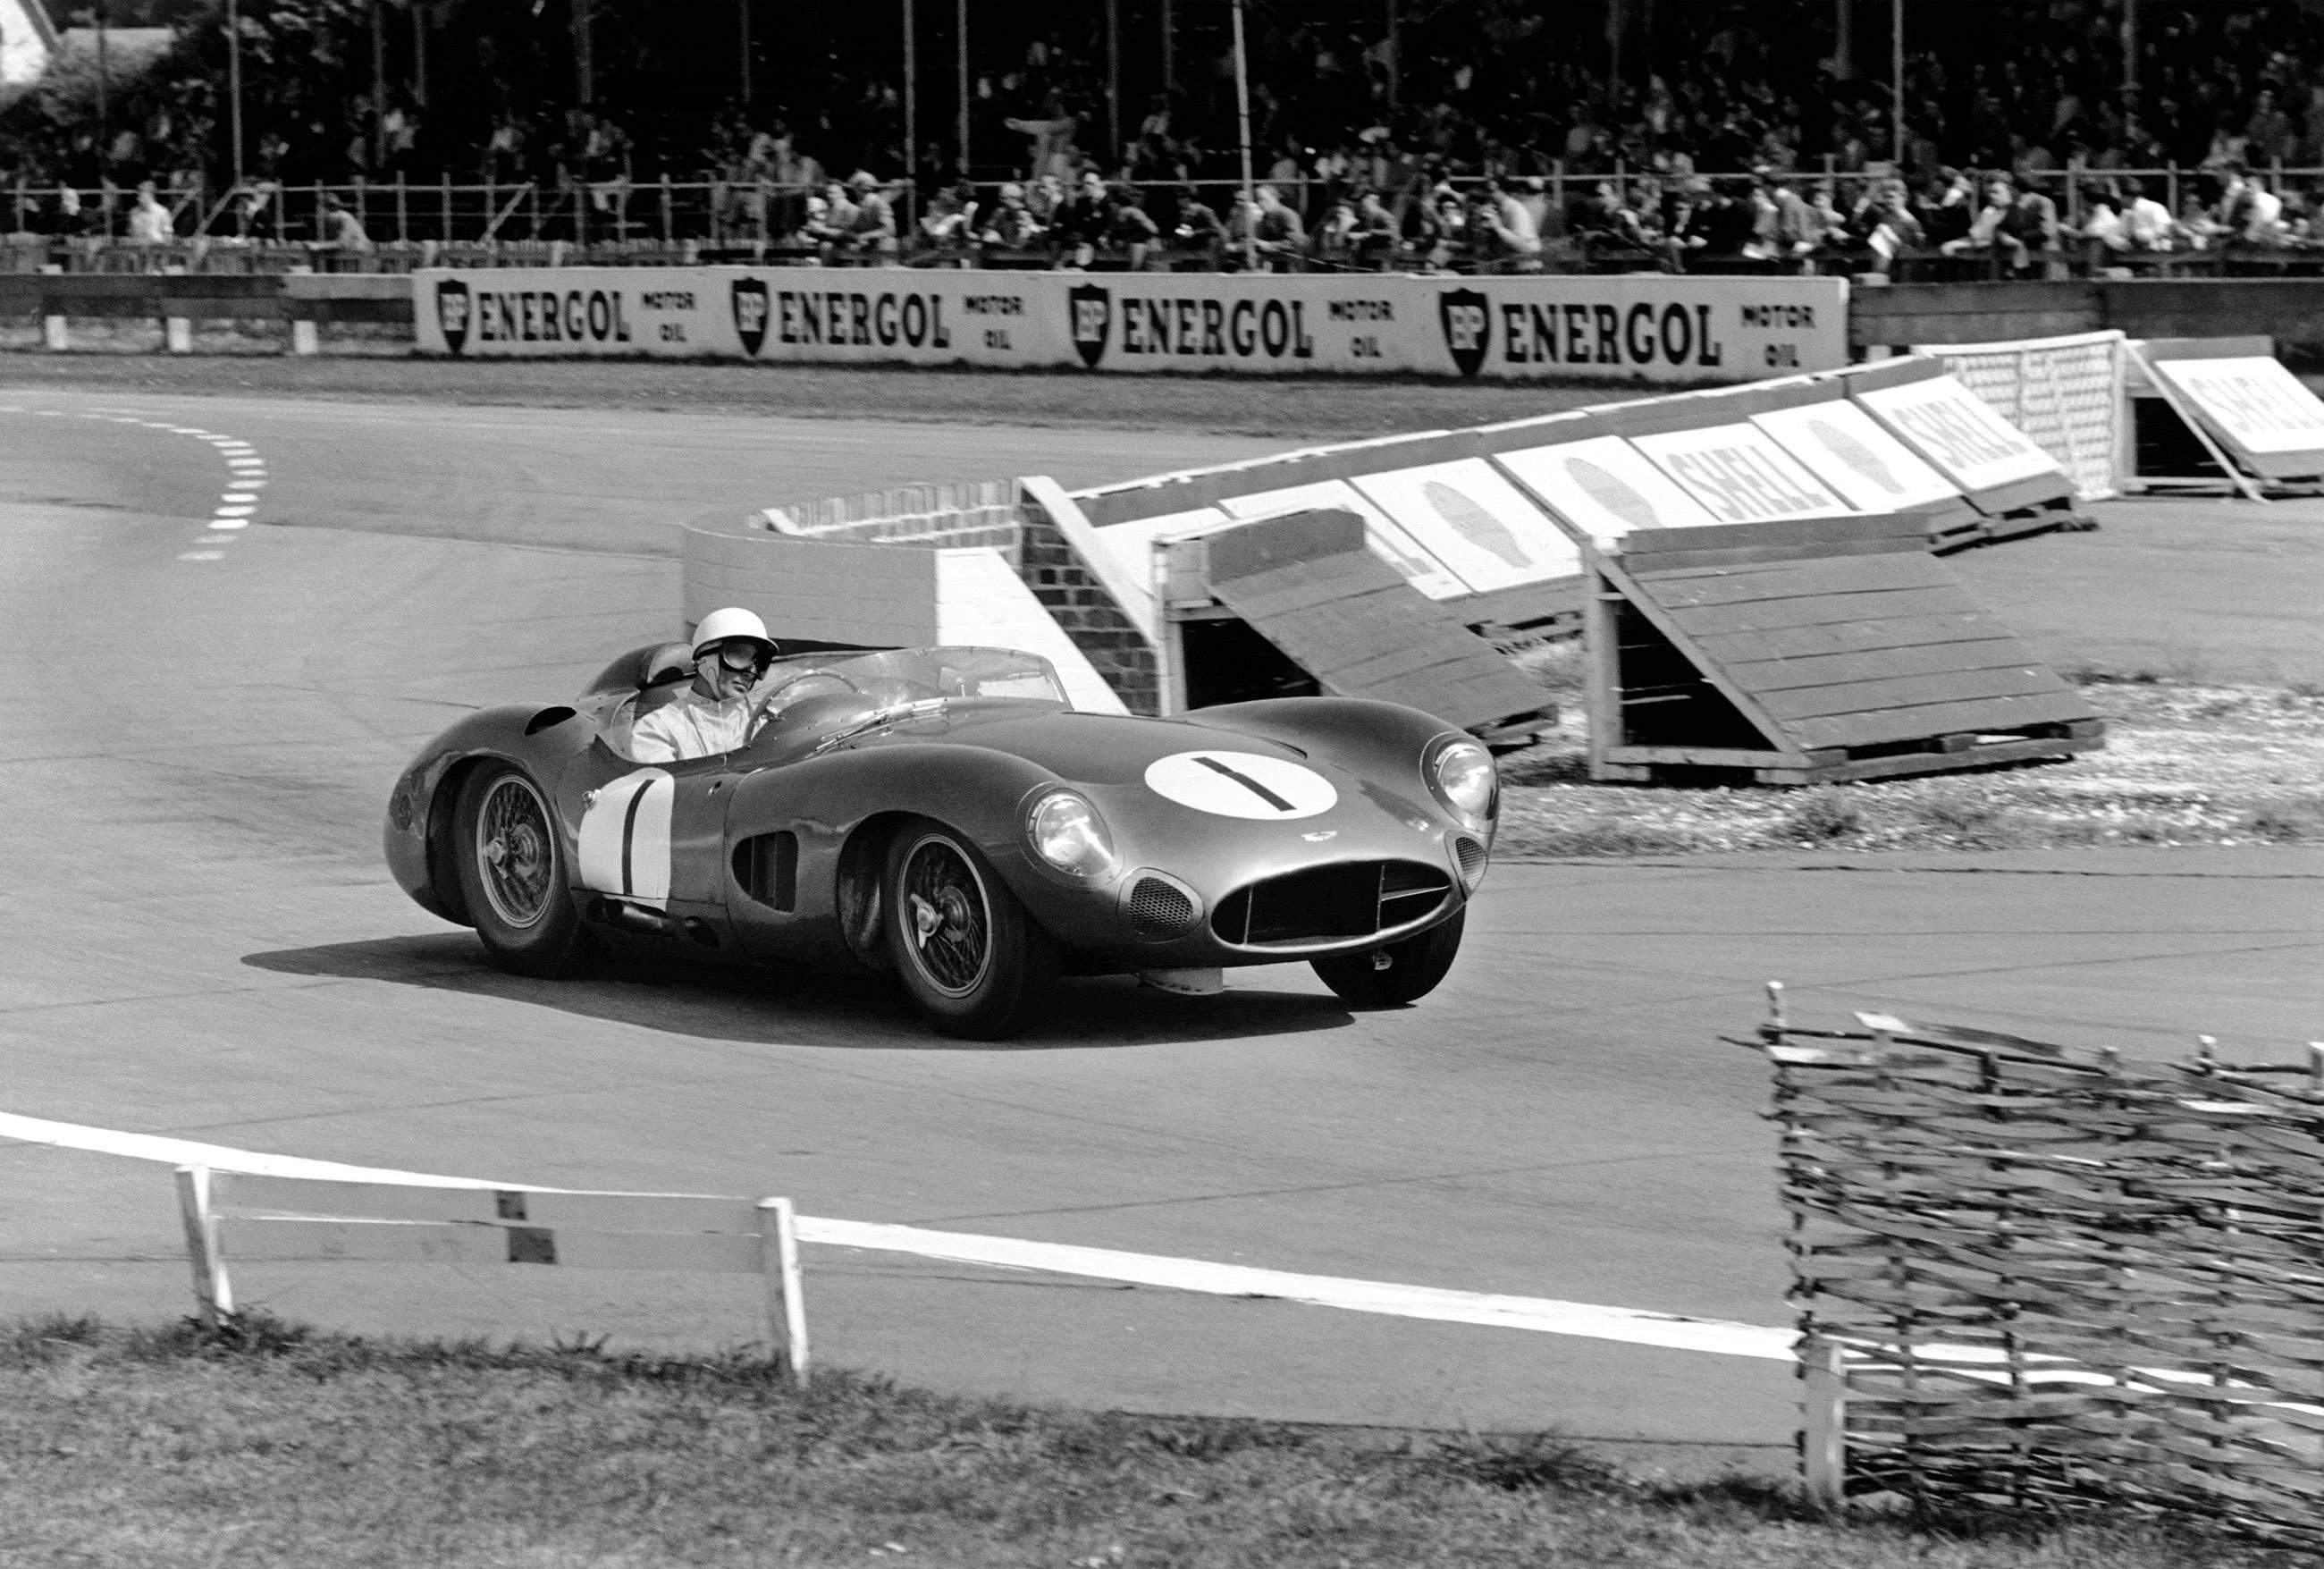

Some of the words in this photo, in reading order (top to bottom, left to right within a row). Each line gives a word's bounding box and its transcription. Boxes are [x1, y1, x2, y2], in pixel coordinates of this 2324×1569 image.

[478, 290, 630, 342] ENERGOL
[737, 291, 766, 333] BP
[778, 291, 950, 348] ENERGOL
[1074, 299, 1107, 342] BP
[1121, 299, 1313, 358] ENERGOL
[1329, 299, 1395, 321] MOTOR
[1447, 305, 1485, 350] BP
[1501, 302, 1722, 367] ENERGOL
[1740, 305, 1815, 329] MOTOR
[1351, 336, 1382, 358] OIL
[1764, 343, 1799, 367] OIL
[1891, 396, 2030, 469] SHELL
[1666, 444, 1831, 520] SHELL
[1191, 756, 1298, 812] 1
[622, 779, 656, 895] 1
